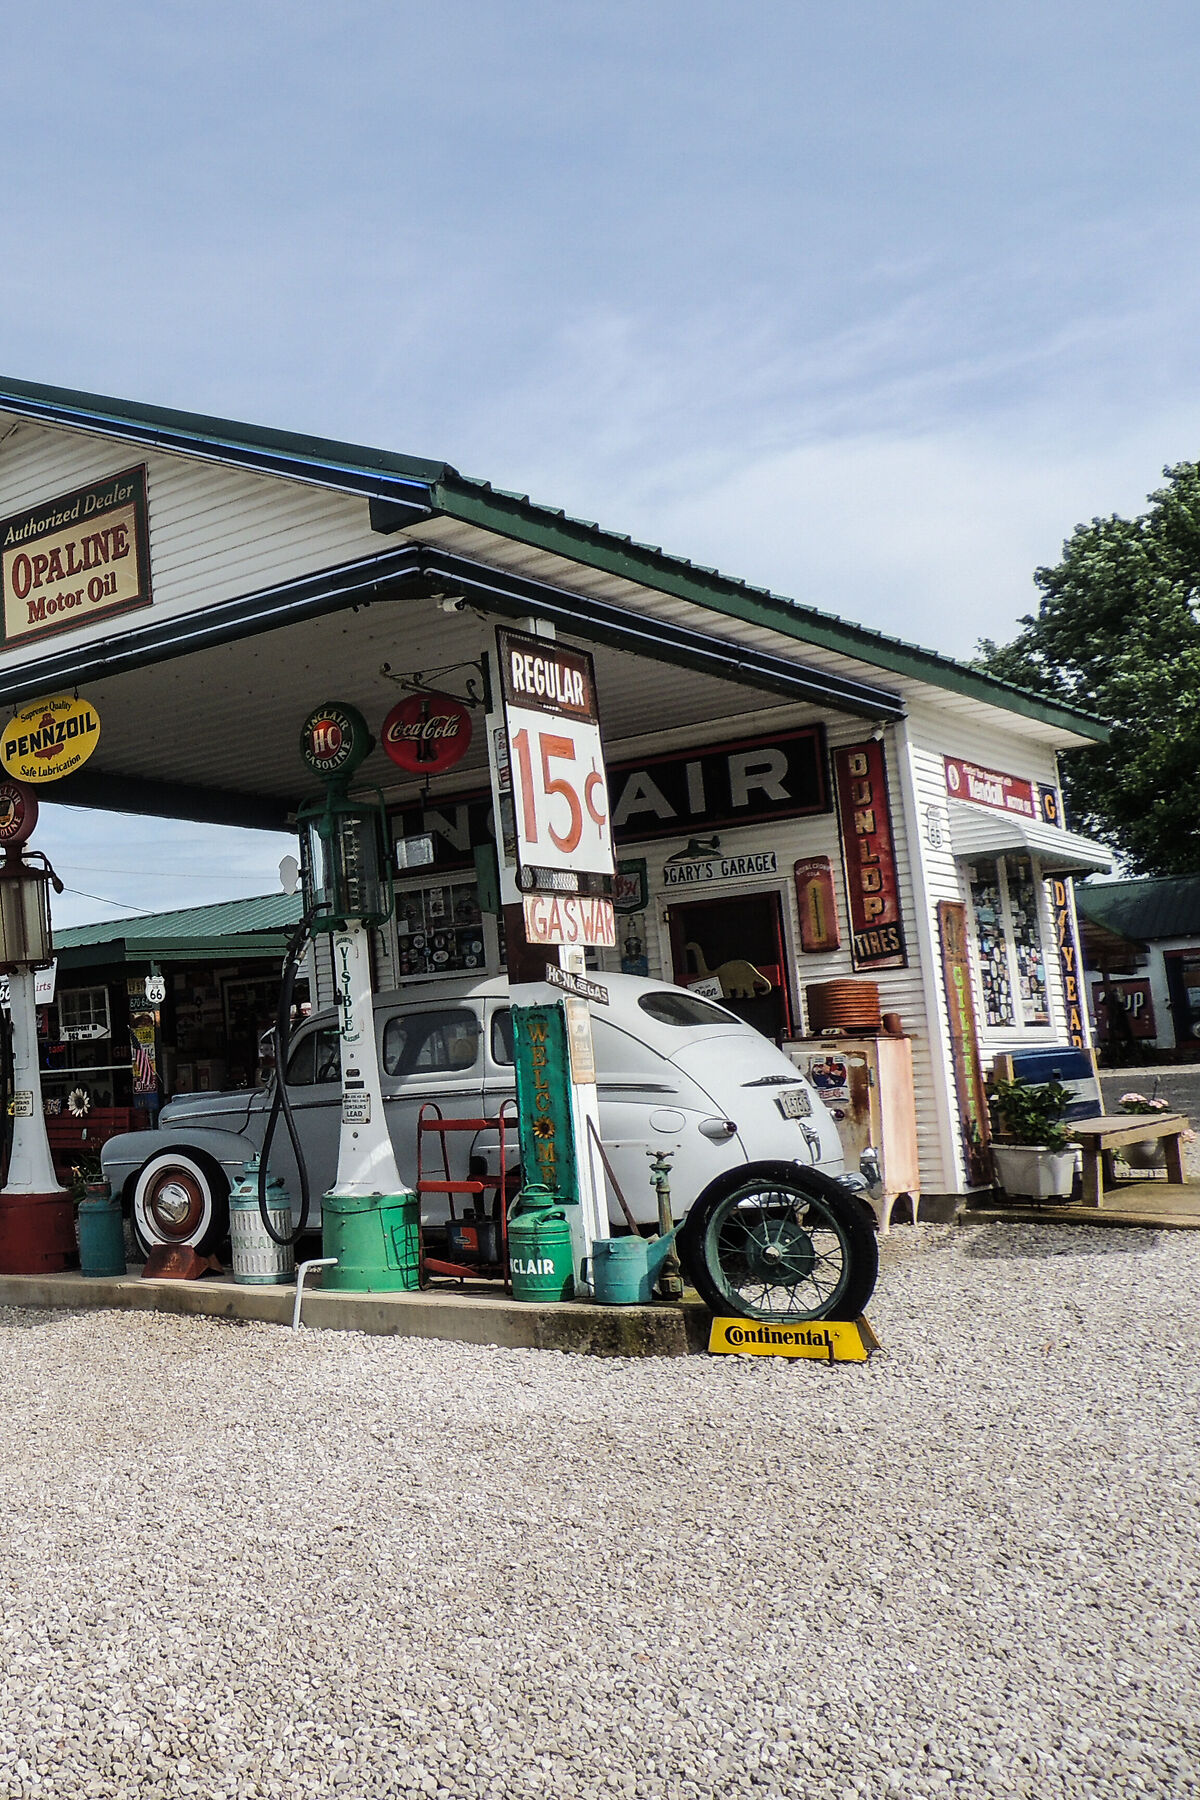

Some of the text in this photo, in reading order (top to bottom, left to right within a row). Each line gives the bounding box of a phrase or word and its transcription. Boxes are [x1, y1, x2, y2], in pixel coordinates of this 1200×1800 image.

[4, 483, 134, 545] Authorized Dealer
[12, 522, 131, 600] OPALINE
[26, 572, 118, 624] Motor Oil
[511, 651, 585, 706] REGULAR
[20, 700, 72, 723] Supreme Quality
[305, 711, 349, 736] SINCLAIR
[5, 711, 97, 761] PENNZOIL
[20, 753, 81, 778] Safe Lubrication
[305, 740, 351, 769] GASOLINE
[847, 752, 884, 923] DUNLOP
[931, 829, 941, 844] 66
[669, 854, 771, 884] GARY'S GARAGE
[855, 926, 900, 961] TIRES
[150, 989, 162, 1000] 66
[339, 947, 353, 1032] VISIBLE
[548, 966, 608, 1002] HONK FOR GAS
[725, 1325, 830, 1346] Continental
